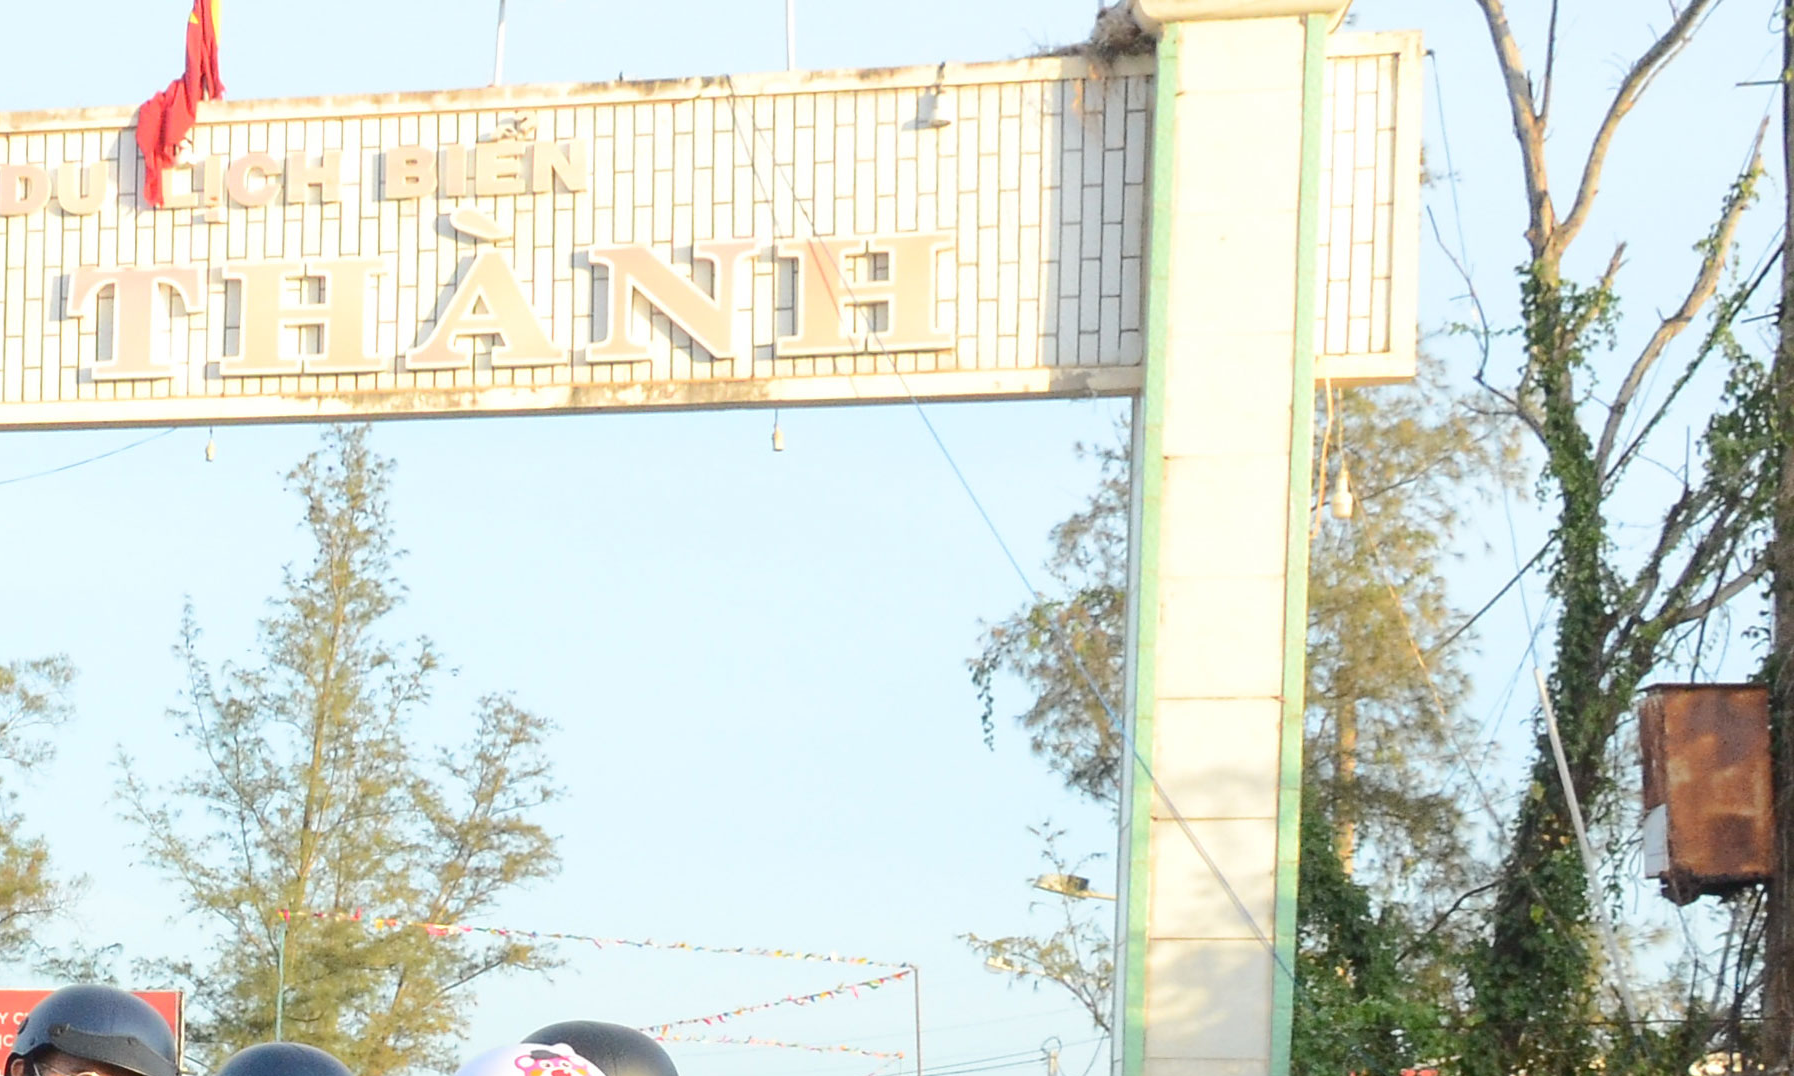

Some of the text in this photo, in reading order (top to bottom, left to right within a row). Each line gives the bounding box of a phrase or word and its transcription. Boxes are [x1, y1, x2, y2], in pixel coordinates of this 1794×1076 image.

[161, 150, 343, 224] LỊCH
[384, 110, 588, 200] BIỂN
[66, 209, 957, 382] THÀNH
[13, 1012, 29, 1024] C
